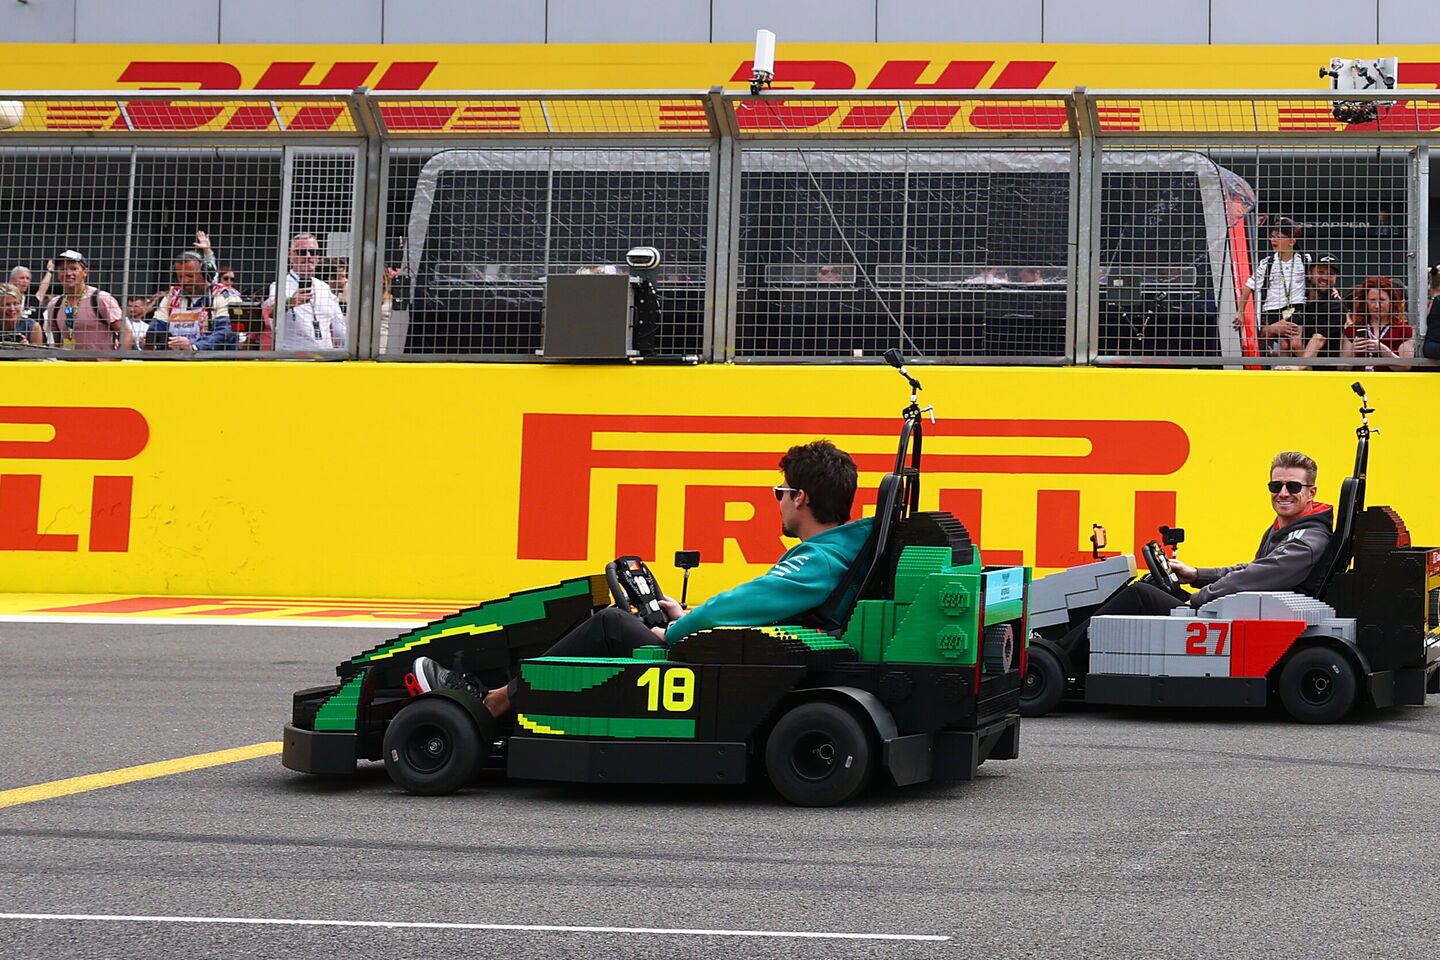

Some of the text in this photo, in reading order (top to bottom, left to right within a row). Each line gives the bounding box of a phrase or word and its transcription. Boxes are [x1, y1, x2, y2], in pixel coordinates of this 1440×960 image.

[110, 61, 457, 130] DHL
[728, 60, 1084, 130] DHL
[516, 412, 1190, 570] PIRLLI
[1186, 622, 1230, 655] 27
[637, 667, 695, 712] 18
